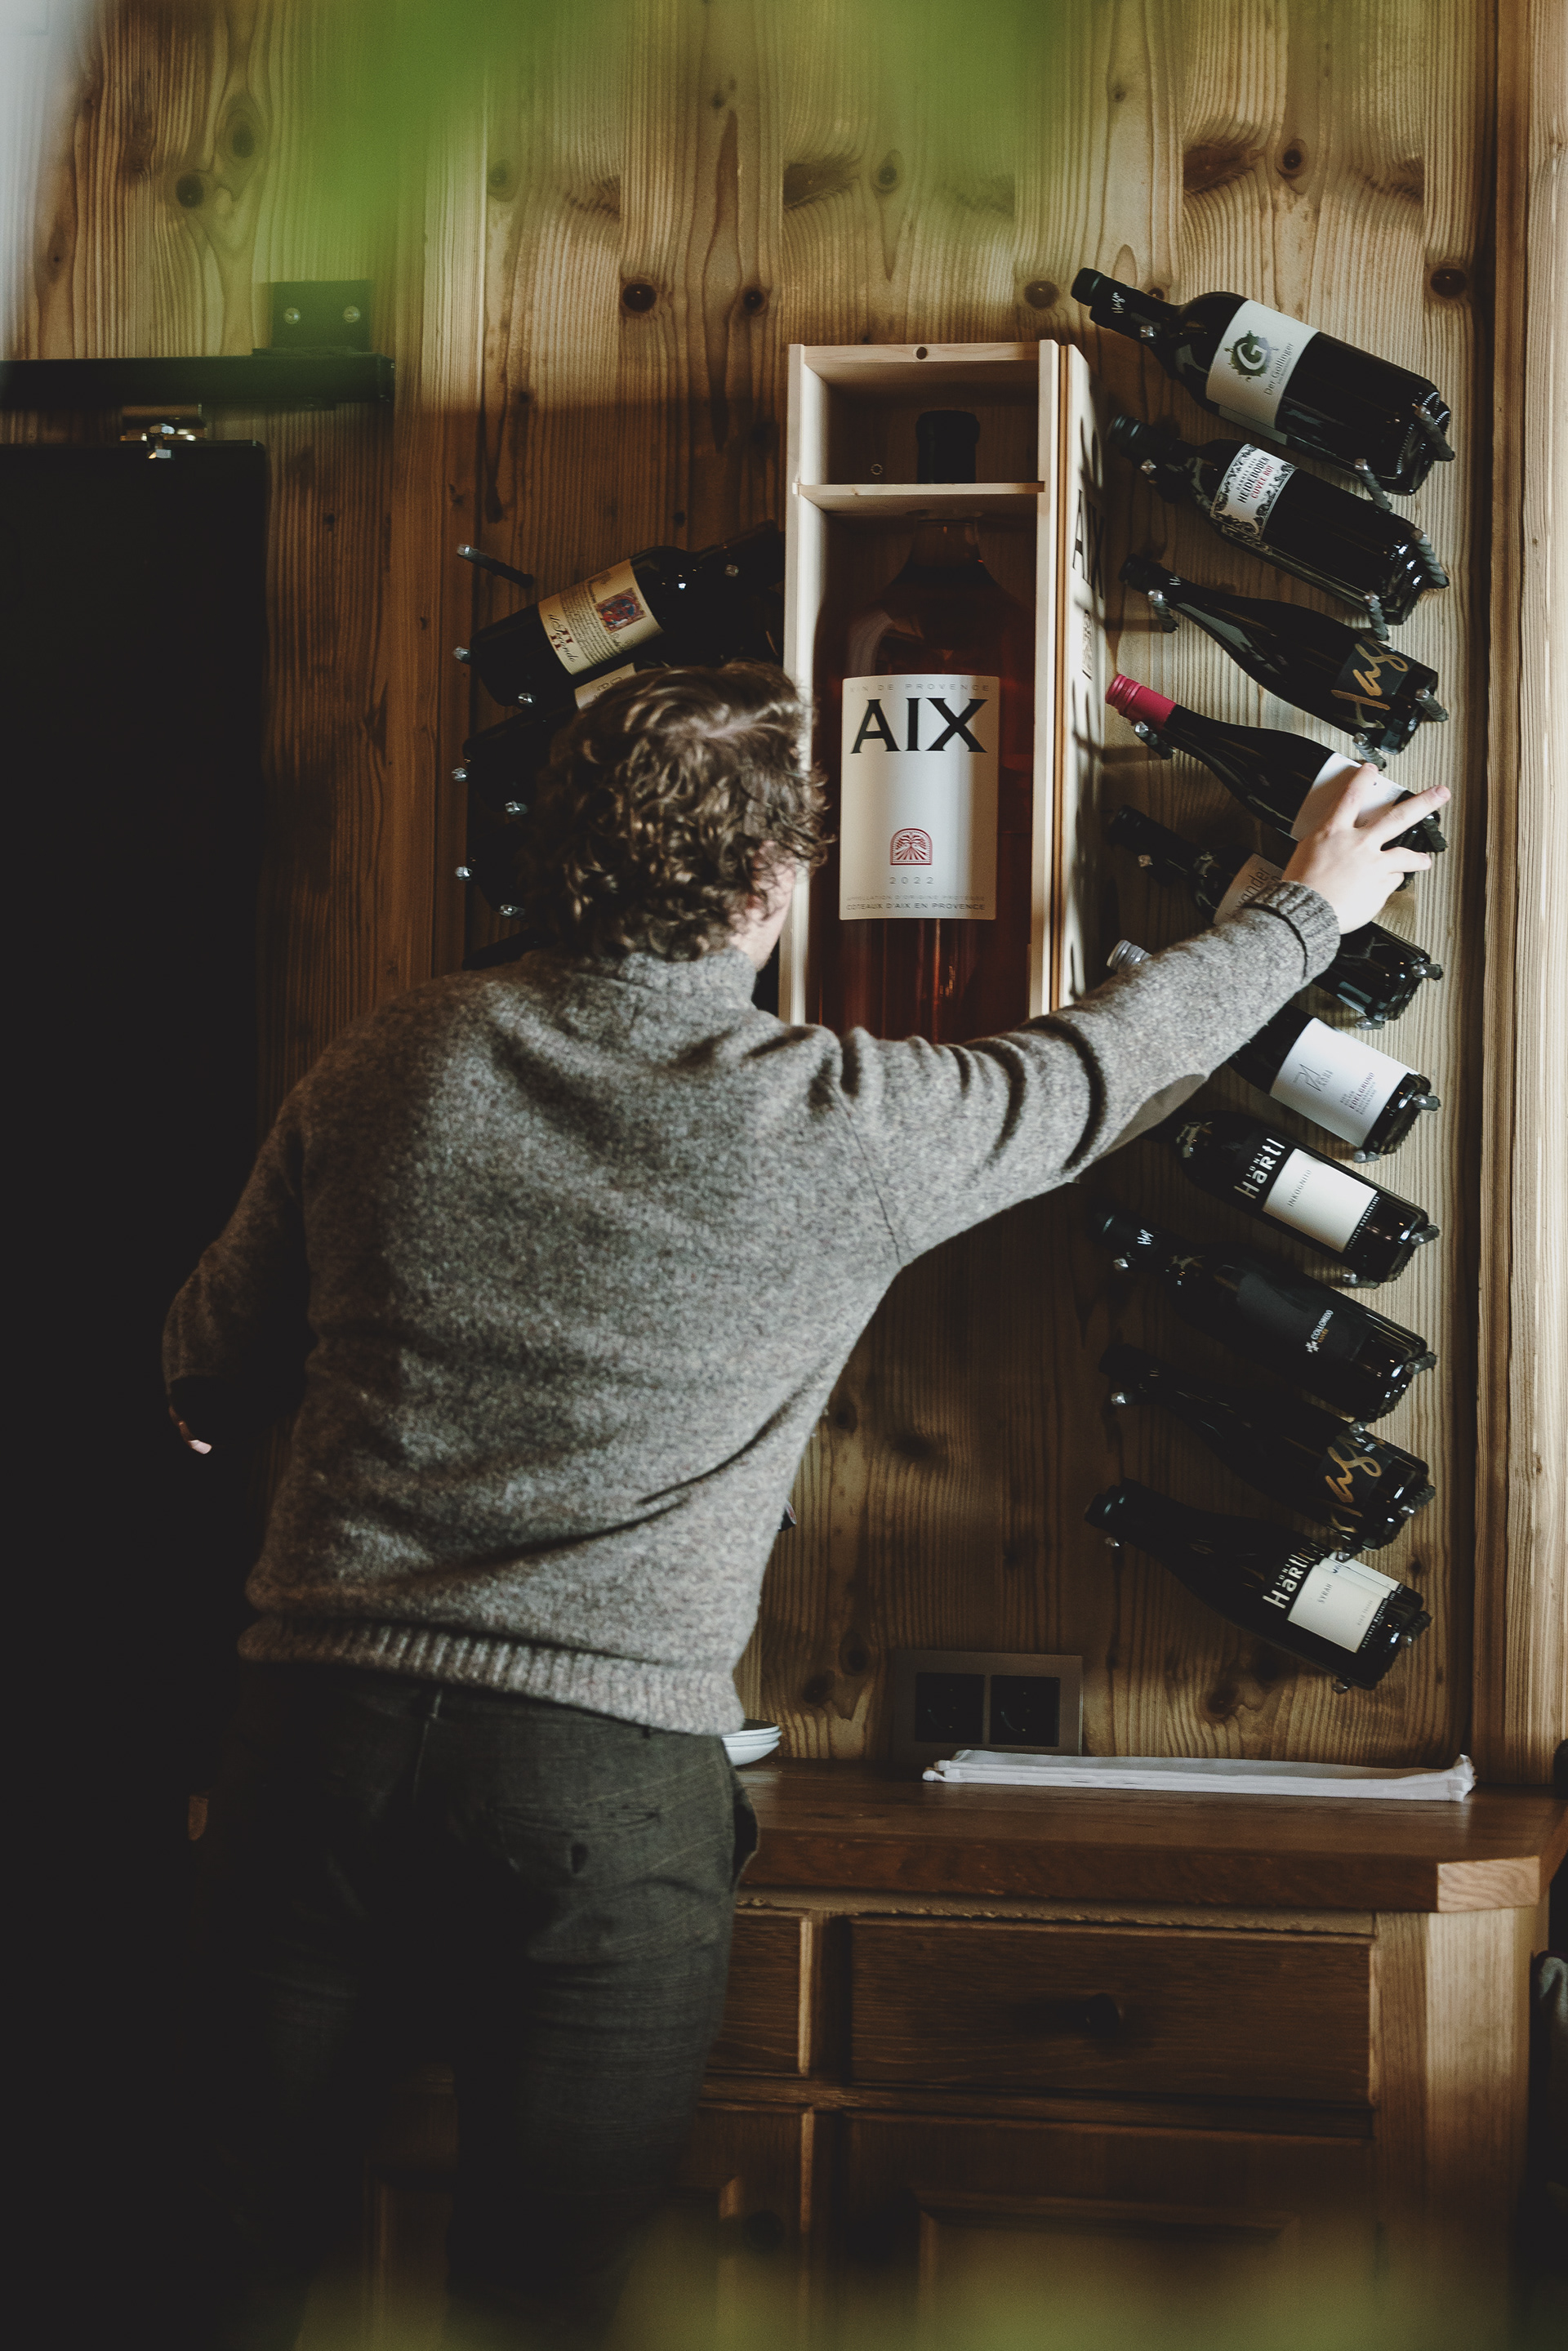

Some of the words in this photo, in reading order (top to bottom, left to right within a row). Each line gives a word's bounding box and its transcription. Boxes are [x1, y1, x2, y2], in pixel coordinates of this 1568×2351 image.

[1263, 379, 1276, 396] Der
[1272, 343, 1294, 378] Gollinger
[1237, 456, 1270, 504] HEIDEBODEN
[905, 683, 990, 692] PROVENCE
[851, 697, 989, 754] AIX
[889, 876, 934, 884] 2022
[845, 902, 884, 911] COTEAUX
[932, 902, 986, 911] PROVENCE
[1287, 1169, 1312, 1208] INKOGNITO
[1310, 1308, 1334, 1341] COLLOREDO
[1318, 1583, 1333, 1604] SYRAH
